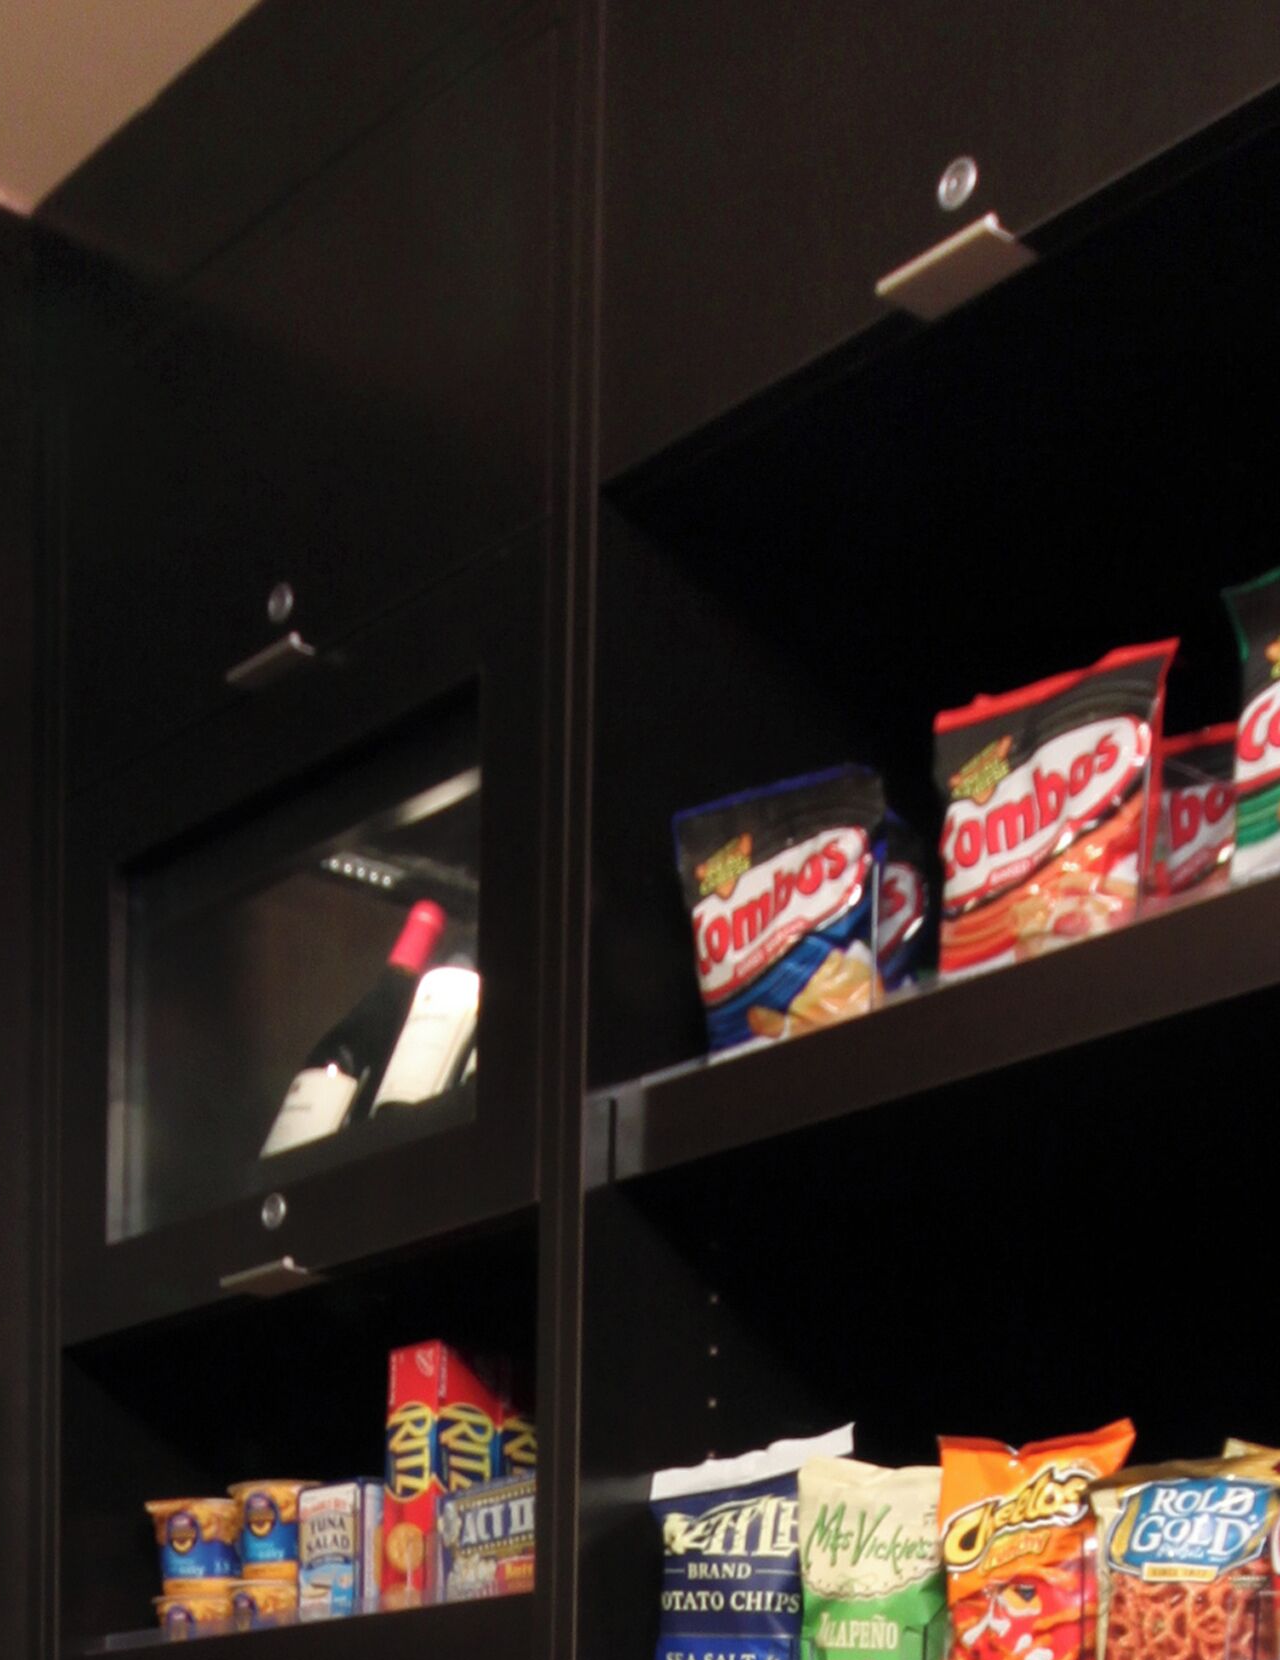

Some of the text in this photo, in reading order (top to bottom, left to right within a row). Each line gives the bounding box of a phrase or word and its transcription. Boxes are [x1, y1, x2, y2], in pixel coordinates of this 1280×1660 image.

[387, 1403, 433, 1497] RITZ
[1149, 1486, 1257, 1515] ROLD
[309, 1516, 347, 1534] TUNA
[461, 1495, 536, 1546] ACT II
[943, 1470, 1087, 1567] Cheetos
[306, 1533, 351, 1552] SALAD
[1130, 1513, 1254, 1556] GOLD
[687, 1562, 752, 1580] BRAND
[661, 1591, 800, 1614] OTATO CHIPS
